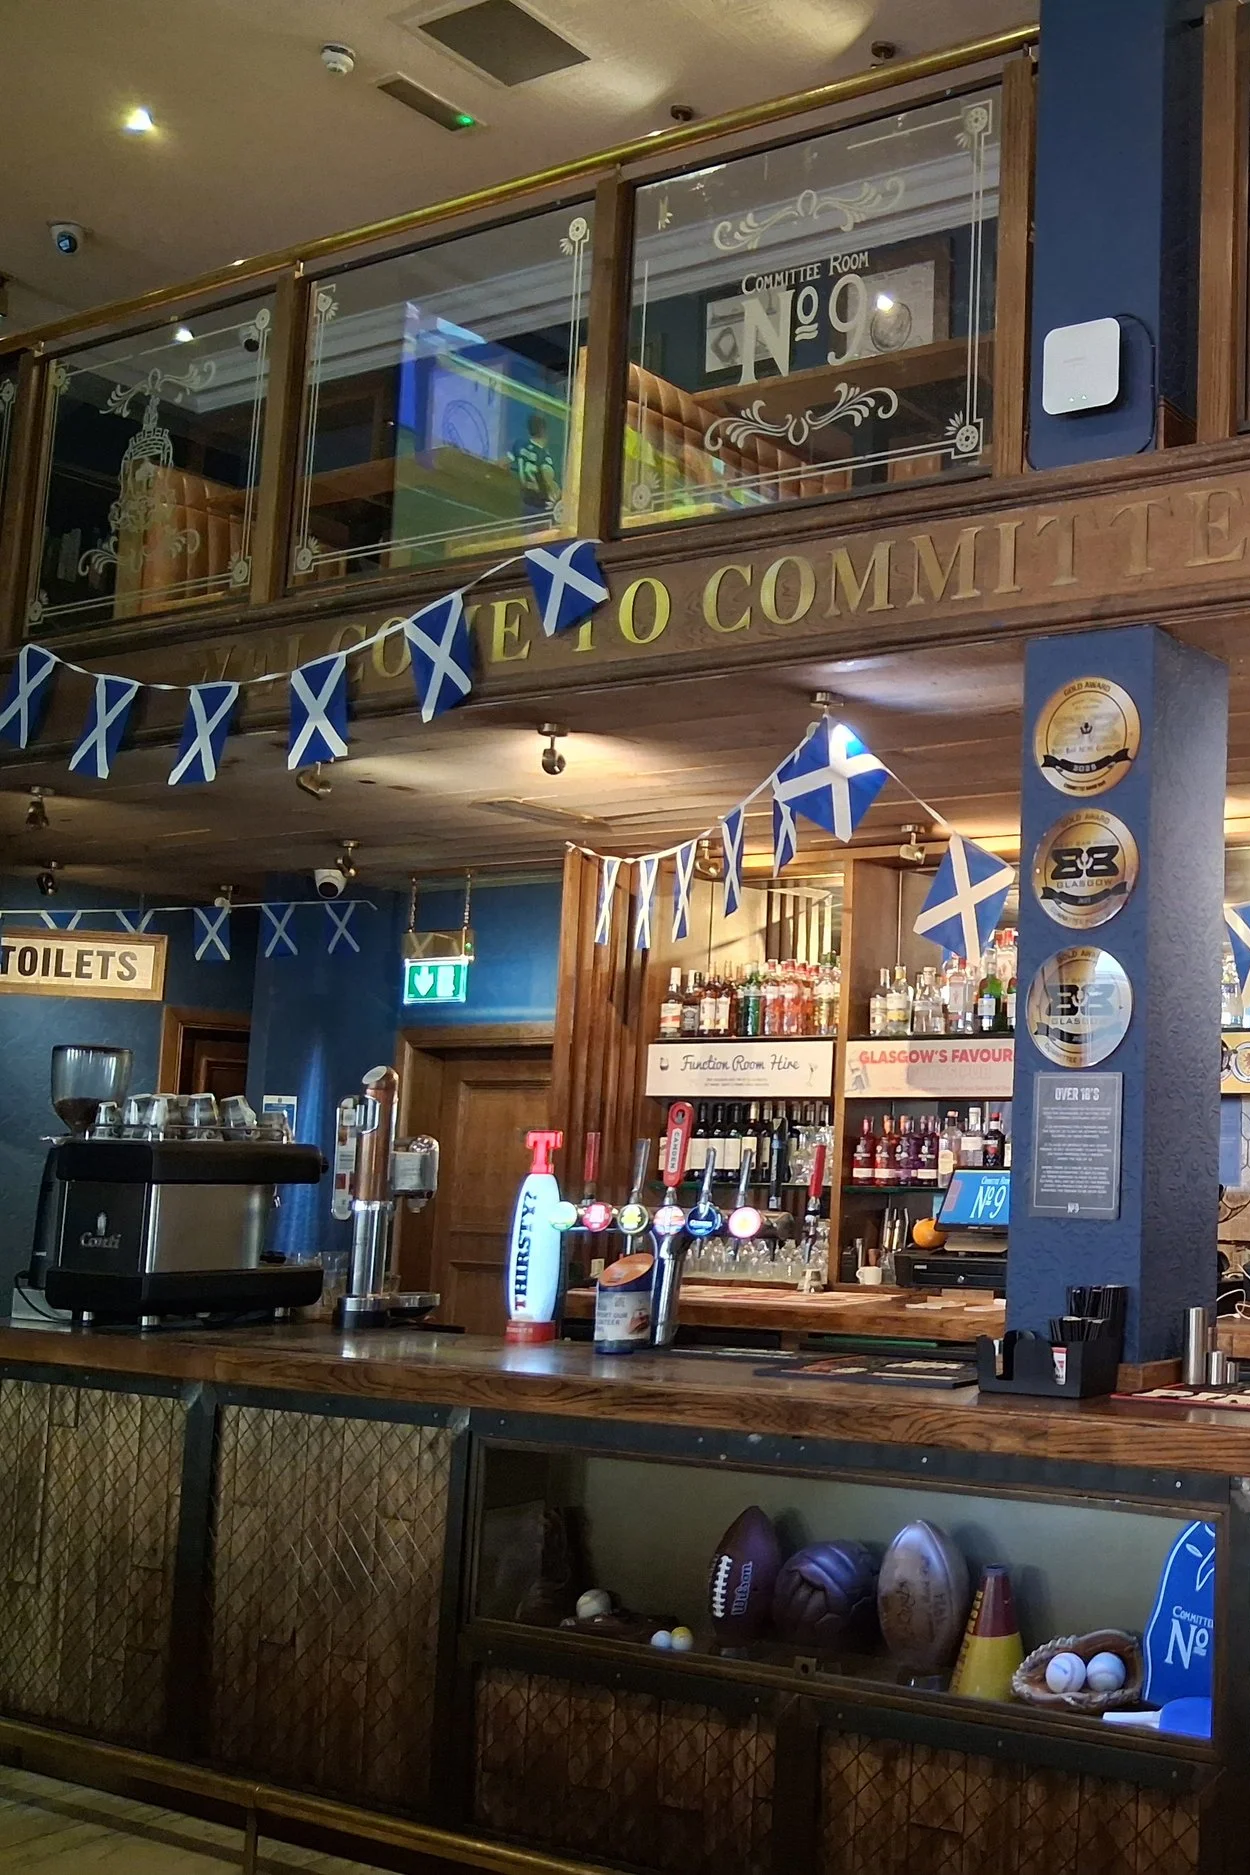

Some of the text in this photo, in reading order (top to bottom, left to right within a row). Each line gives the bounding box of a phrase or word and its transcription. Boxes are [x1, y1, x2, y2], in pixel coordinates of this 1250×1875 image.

[741, 251, 870, 296] COMMITTEE ROOM
[1056, 878, 1113, 889] GLASGOW
[0, 944, 138, 982] TOILETS
[680, 1052, 801, 1072] Function Room Hire
[858, 1049, 949, 1065] GLASGOW'S
[1054, 1087, 1100, 1101] OVER 18'S
[670, 1131, 681, 1171] CAMDEN
[514, 1190, 538, 1312] THIRSTY?
[730, 1560, 753, 1617] Wilson
